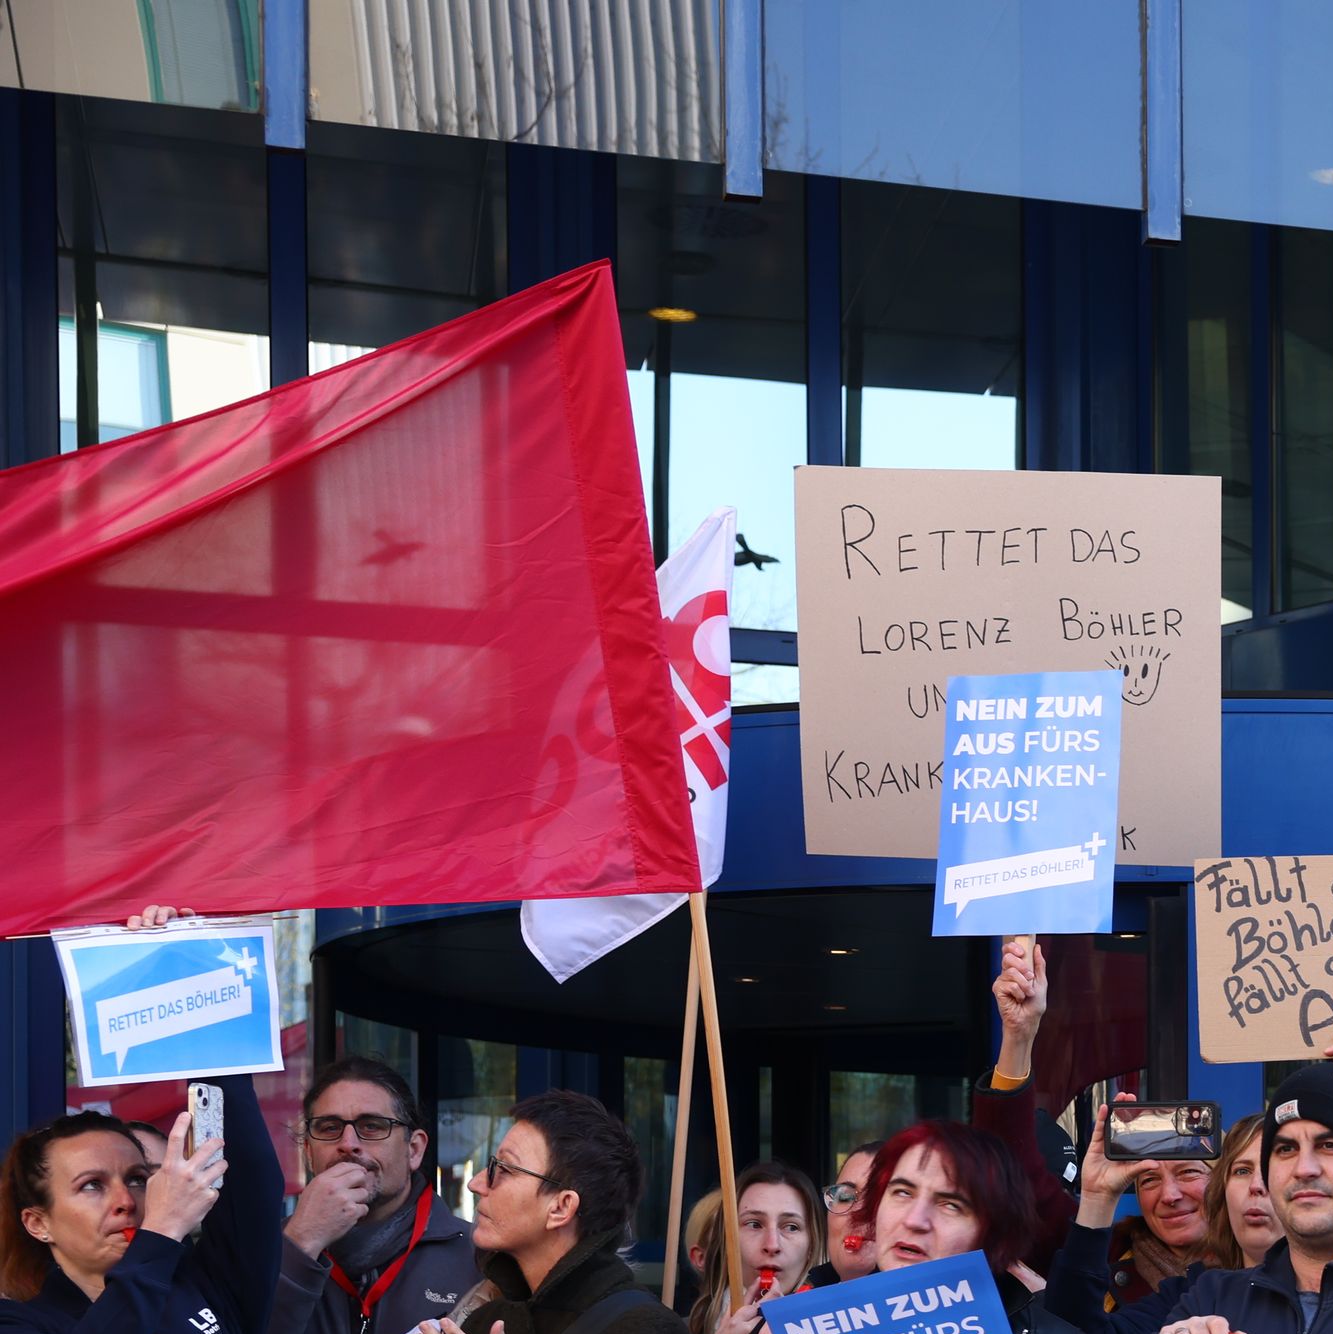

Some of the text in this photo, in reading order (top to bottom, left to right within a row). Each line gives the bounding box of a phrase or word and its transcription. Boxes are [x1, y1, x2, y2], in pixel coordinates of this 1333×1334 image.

[841, 503, 1142, 580] RETTET DAS
[858, 615, 1013, 655] LORENZ
[955, 695, 1103, 722] NEIN ZUM
[952, 725, 1102, 756] AUS FÜRS
[953, 764, 1107, 790] KRANKEN-
[951, 799, 1039, 824] HAUS!
[953, 858, 1085, 890] RETTET DAS BÖHLER!
[1195, 856, 1307, 913] Fällt
[108, 983, 241, 1034] RETTET DAS BÖHLER!
[1223, 954, 1311, 1028] fällt
[885, 1280, 975, 1321] ZUM
